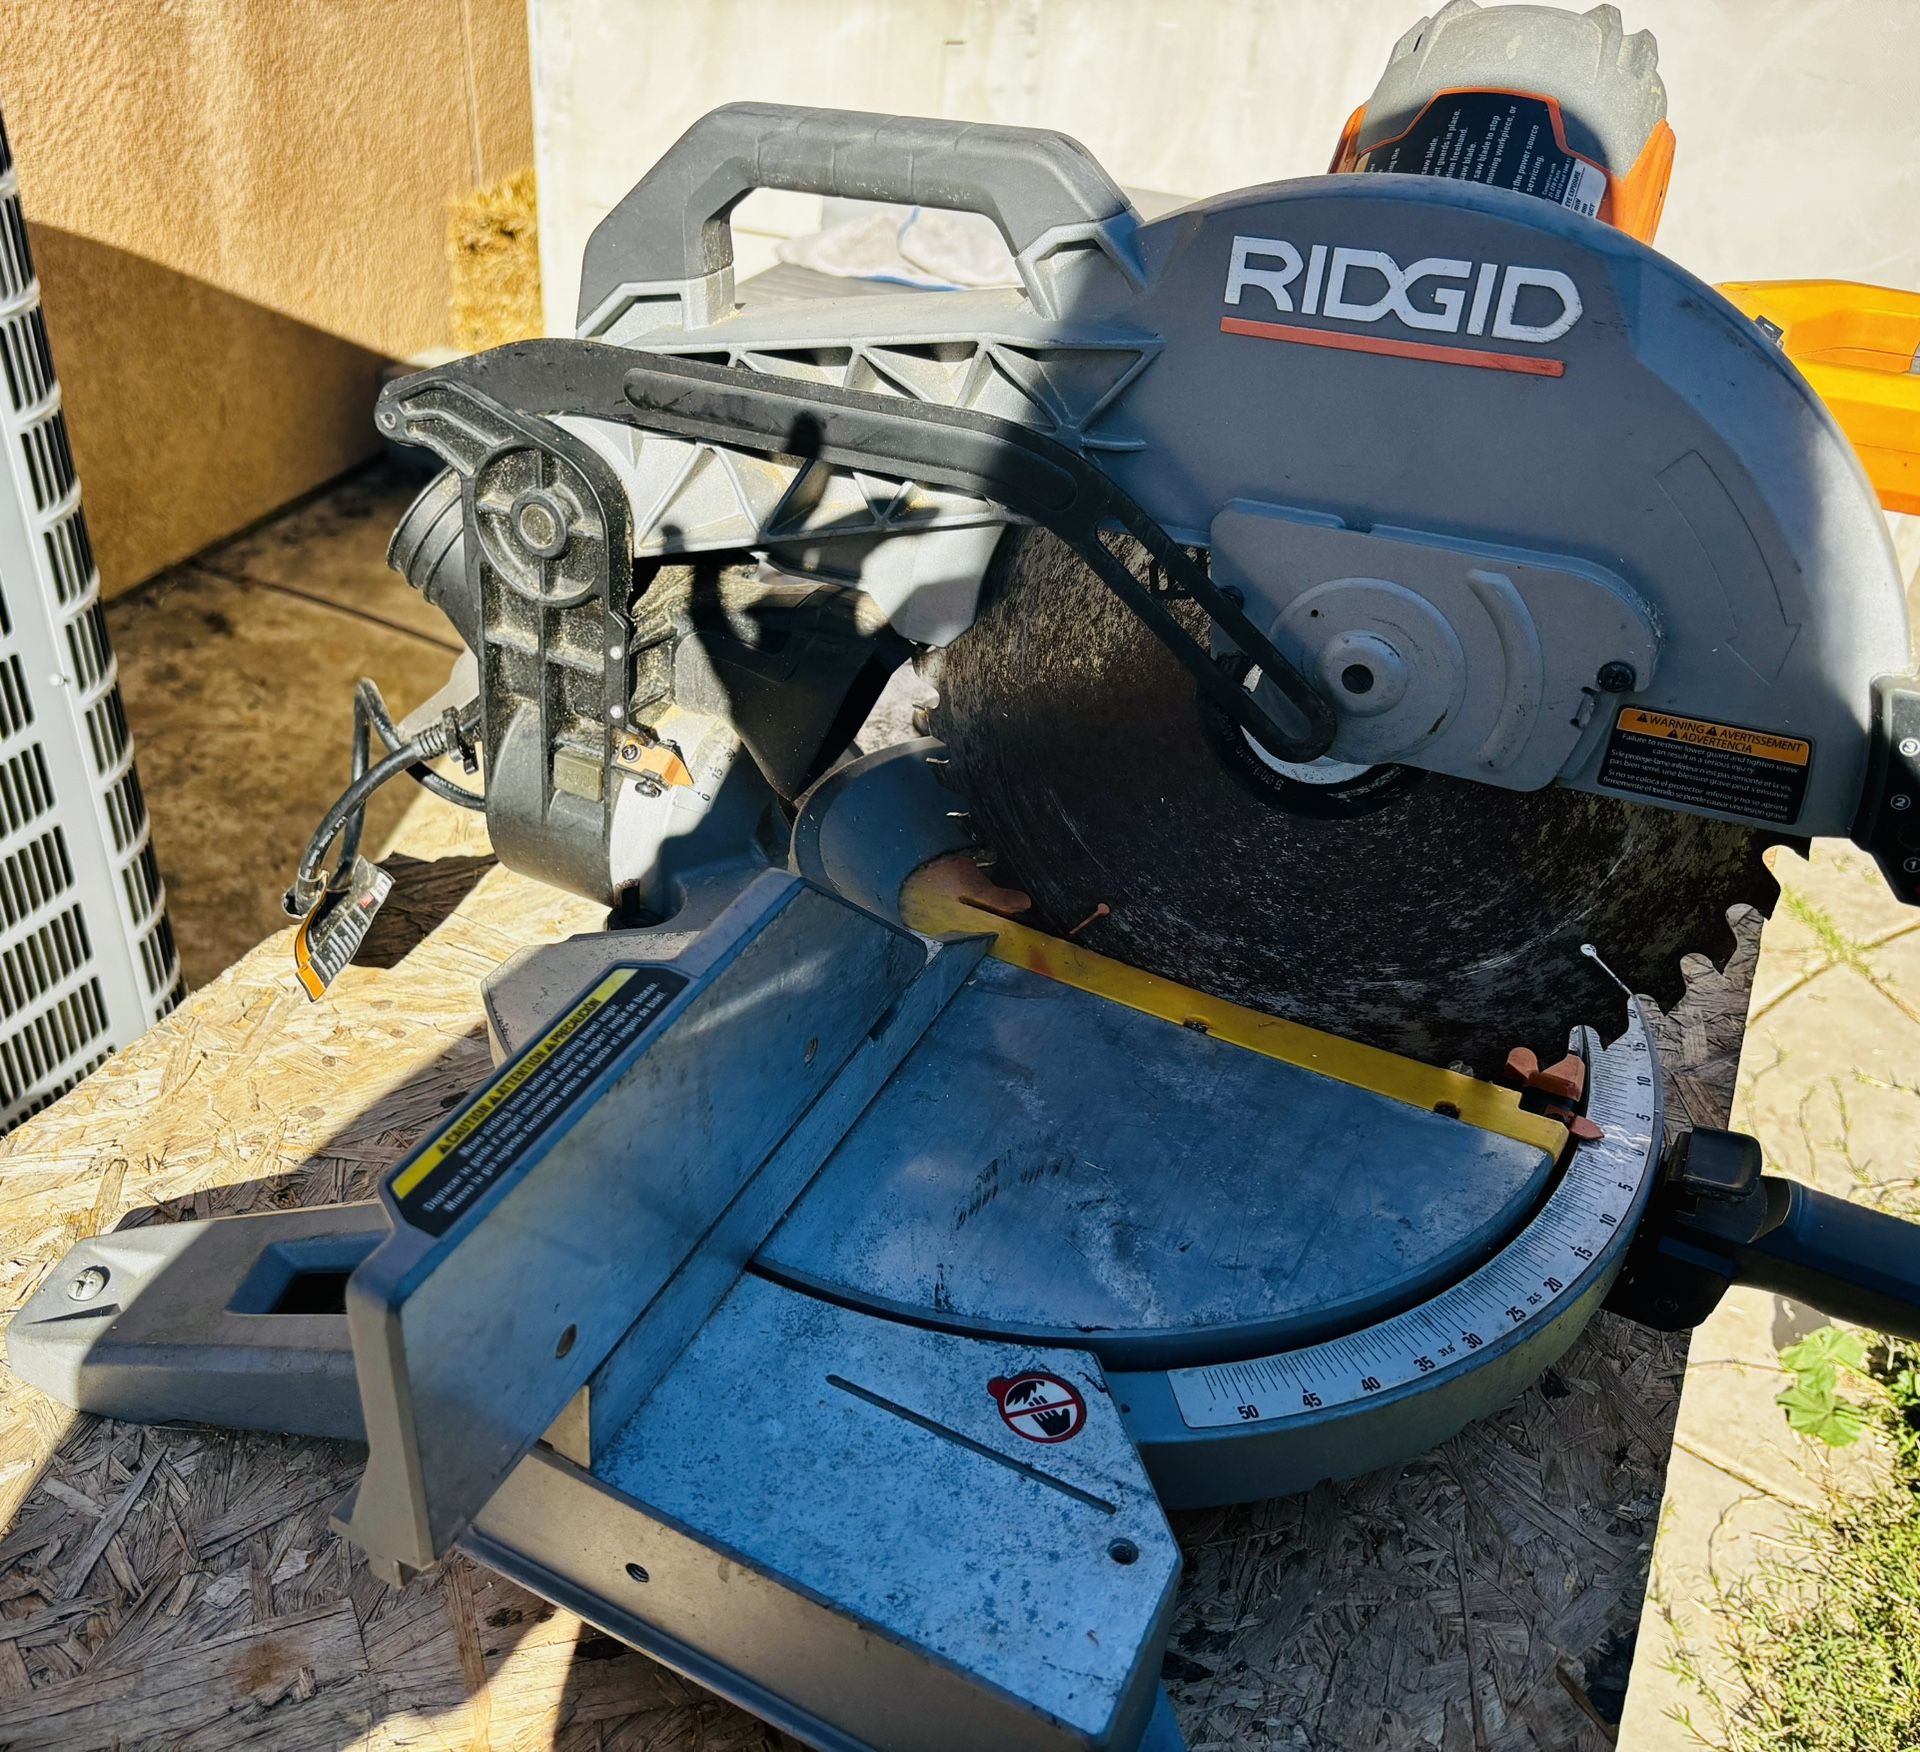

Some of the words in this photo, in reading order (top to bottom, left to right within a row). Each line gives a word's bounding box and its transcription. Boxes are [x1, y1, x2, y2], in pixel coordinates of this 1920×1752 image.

[1488, 114, 1501, 131] stop
[1436, 140, 1451, 166] guards
[1447, 107, 1462, 130] place.
[1449, 126, 1468, 161] freehand.
[1484, 157, 1501, 183] moving
[1493, 114, 1515, 156] workpiece,
[1508, 105, 1516, 113] or
[1424, 134, 1439, 158] blade.
[1462, 140, 1477, 164] blade.
[1476, 140, 1491, 161] blade
[1511, 174, 1520, 185] the
[1517, 150, 1532, 174] power
[1525, 124, 1539, 149] source
[1420, 158, 1431, 174] saw
[1472, 162, 1484, 178] saw
[1524, 153, 1545, 192] servicing.
[1567, 170, 1581, 196] EXPOSURE
[1564, 196, 1572, 207] EYE
[1224, 235, 1584, 344] RIDGID
[1648, 715, 1704, 734] WARNING
[1719, 728, 1802, 753] AVERTISSEMENT
[1681, 731, 1753, 753] ADVERTENCIA
[1622, 733, 1646, 743] Failure
[1656, 740, 1682, 750] restore
[1684, 746, 1705, 755] lower
[1705, 750, 1729, 760] guard
[1729, 754, 1745, 763] and
[1745, 758, 1774, 769] tighten
[1775, 764, 1798, 773] screw
[1666, 750, 1688, 760] result
[1703, 758, 1730, 768] serious
[712, 768, 723, 780] 15
[1609, 758, 1622, 766] pas
[1623, 759, 1640, 768] bien
[1677, 770, 1709, 782] blessure
[1708, 778, 1730, 788] grave
[1731, 782, 1749, 792] peut
[1716, 772, 1730, 780] pas
[1602, 775, 1644, 790] firmemente
[1644, 784, 1652, 792] el
[1652, 786, 1674, 796] tornillo
[1635, 774, 1660, 785] coloca
[1667, 781, 1702, 794] protector
[1705, 788, 1732, 800] inferior
[1760, 801, 1788, 813] aprieta
[701, 793, 711, 801] 0
[1633, 1042, 1647, 1051] 15
[458, 1133, 487, 1157] Move
[480, 1108, 513, 1136] sliding
[505, 1089, 532, 1111] fence
[525, 1068, 553, 1092] before
[548, 1038, 586, 1069] adjusting
[578, 1020, 603, 1040] bevel
[597, 1000, 624, 1023] angle.
[468, 1143, 498, 1167] guide
[519, 1078, 562, 1115] coulissant
[555, 1060, 580, 1080] avant
[574, 1051, 588, 1062] de
[624, 1001, 640, 1012] de
[491, 1131, 530, 1163] ingletes
[521, 1094, 564, 1131] deslizable
[558, 1076, 583, 1096] antes
[577, 1066, 592, 1078] de
[586, 1045, 616, 1069] ajustar
[608, 1036, 623, 1046] el
[637, 1006, 652, 1017] de
[1636, 1075, 1652, 1087] 10
[445, 1104, 491, 1143] CAUTION
[496, 1049, 548, 1094] ATTENTION
[1635, 1112, 1651, 1122] 5
[1617, 1181, 1634, 1192] 5
[1599, 1213, 1617, 1228] 10
[1574, 1246, 1593, 1261] 15
[1543, 1276, 1563, 1294] 20
[1505, 1306, 1527, 1323] 25
[1462, 1332, 1483, 1350] 30
[1413, 1355, 1436, 1373] 35
[1361, 1376, 1381, 1393] 40
[1302, 1392, 1322, 1408] 45
[1237, 1403, 1260, 1420] 50
